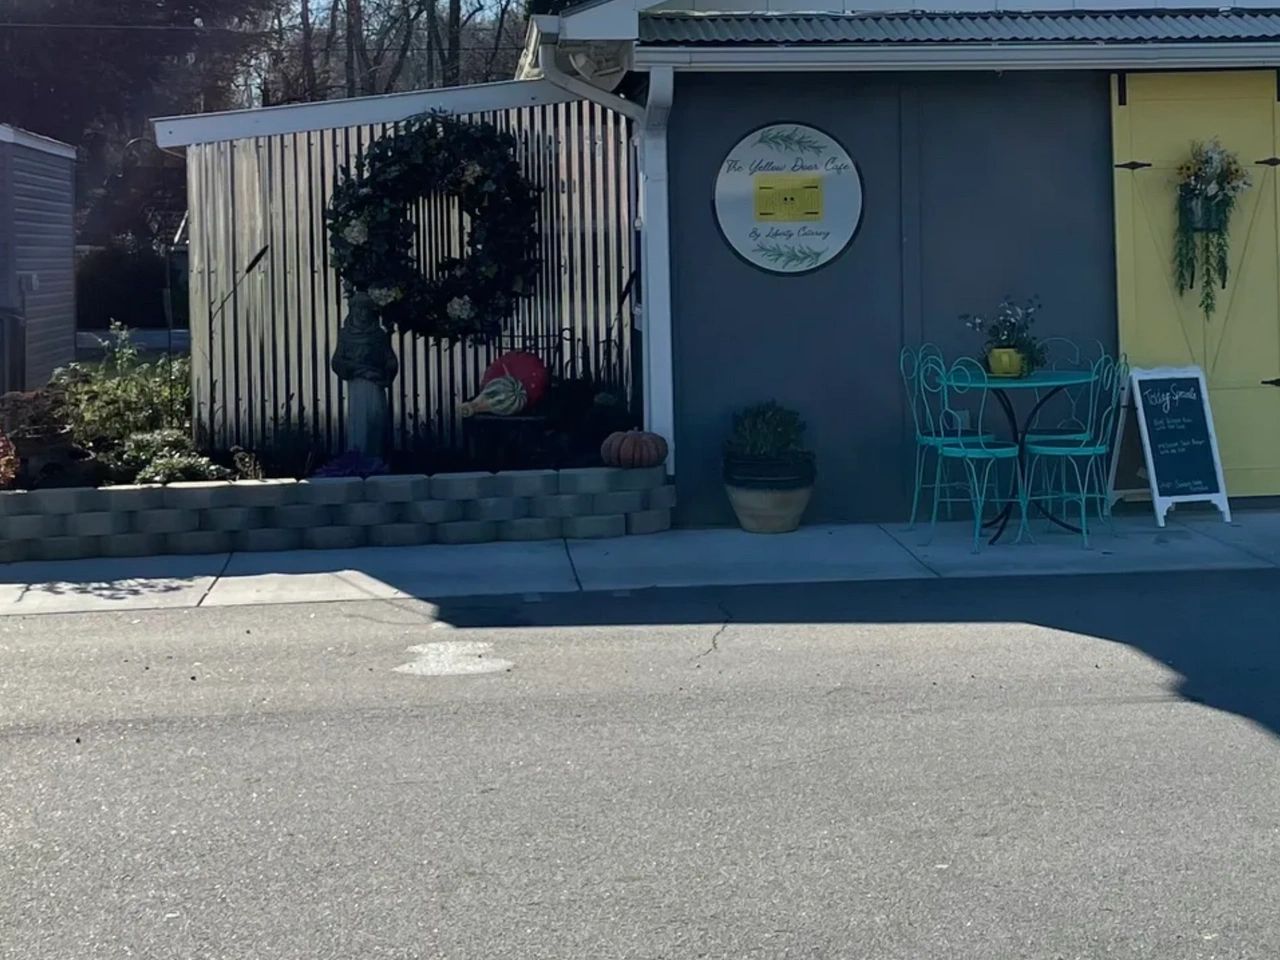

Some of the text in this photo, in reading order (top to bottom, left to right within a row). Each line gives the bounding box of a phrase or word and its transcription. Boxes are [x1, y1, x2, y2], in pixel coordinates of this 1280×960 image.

[726, 159, 743, 173] The
[749, 158, 786, 176] Yellow
[791, 157, 819, 172] Door
[749, 227, 761, 239] By
